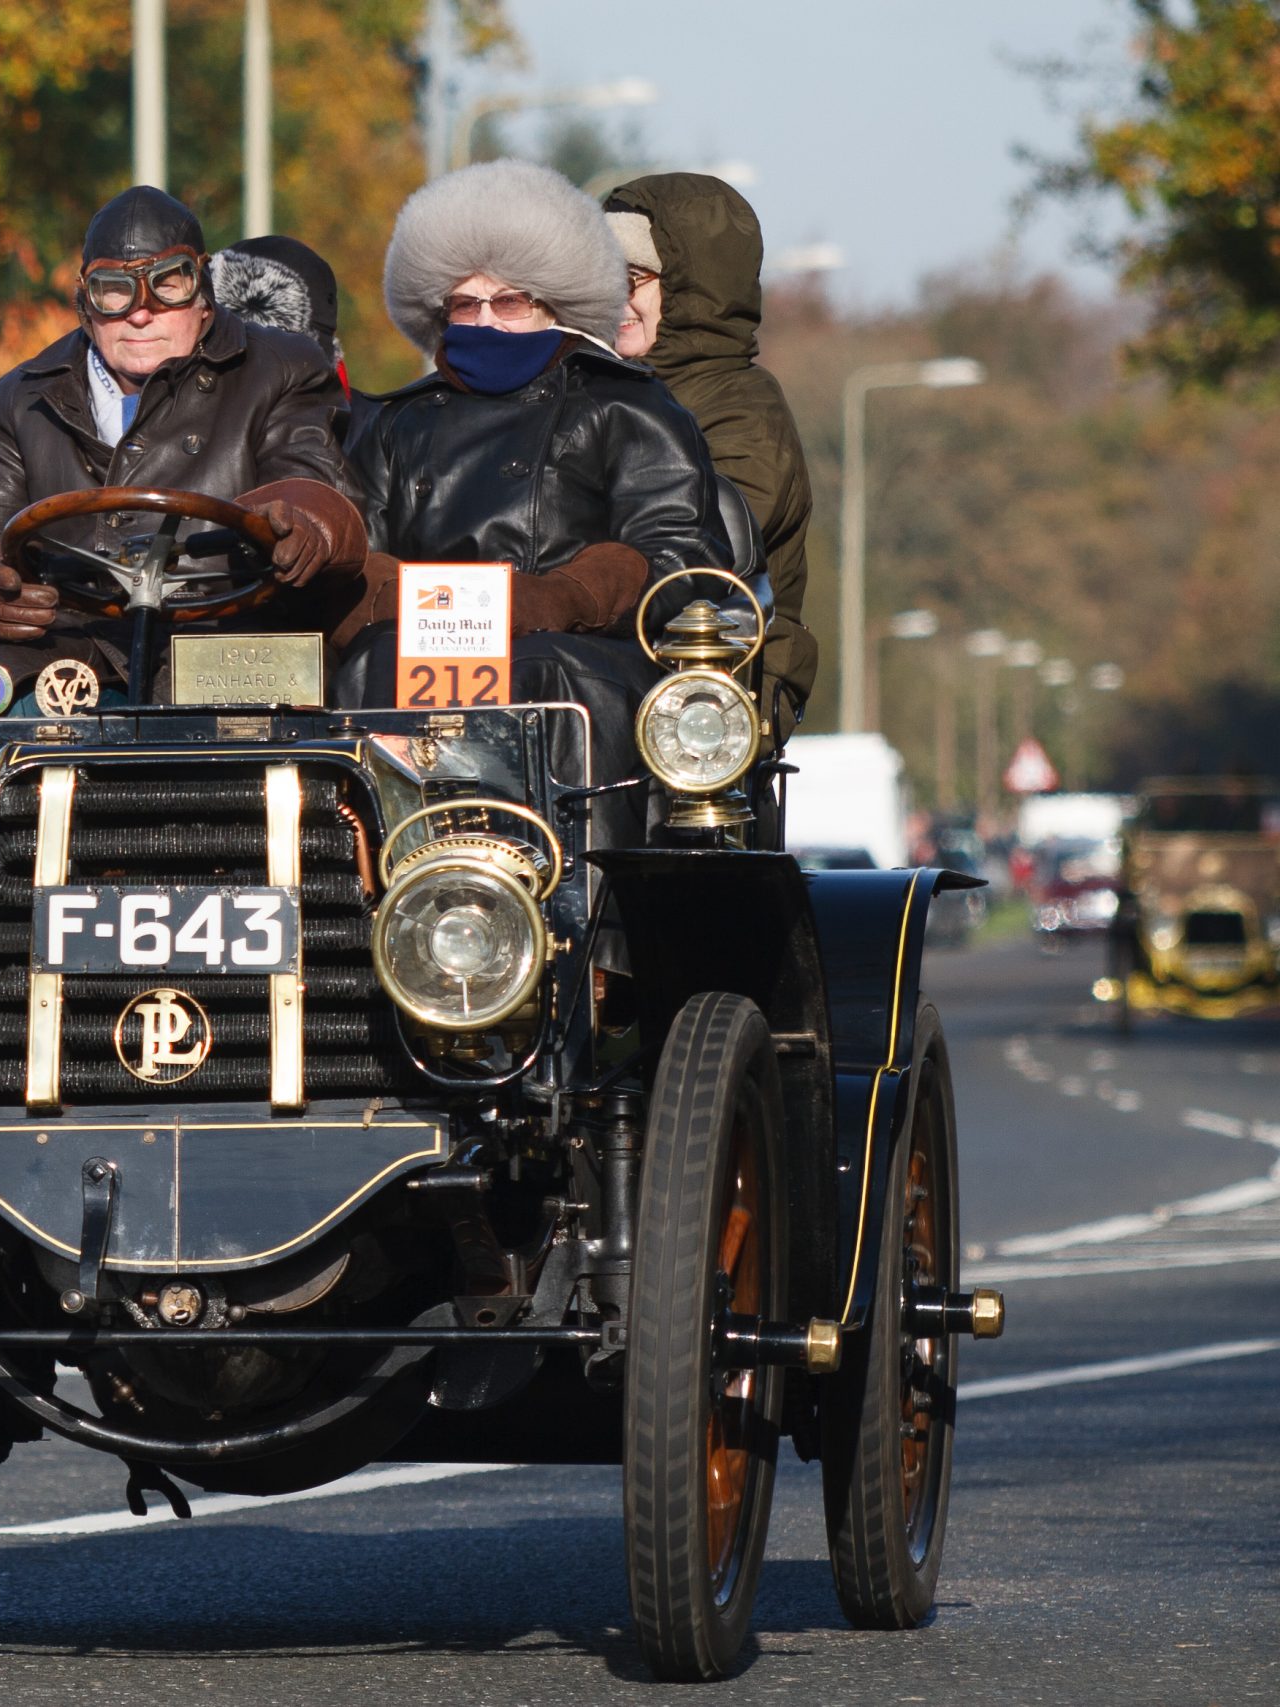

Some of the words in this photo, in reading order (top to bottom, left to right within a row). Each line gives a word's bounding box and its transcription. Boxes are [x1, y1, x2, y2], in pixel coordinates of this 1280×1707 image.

[418, 618, 456, 633] Daily
[460, 619, 491, 630] Mail
[220, 648, 273, 665] 1902
[196, 673, 277, 688] PANHARD
[287, 673, 298, 688] &
[410, 665, 499, 707] 212
[48, 894, 283, 965] F-643
